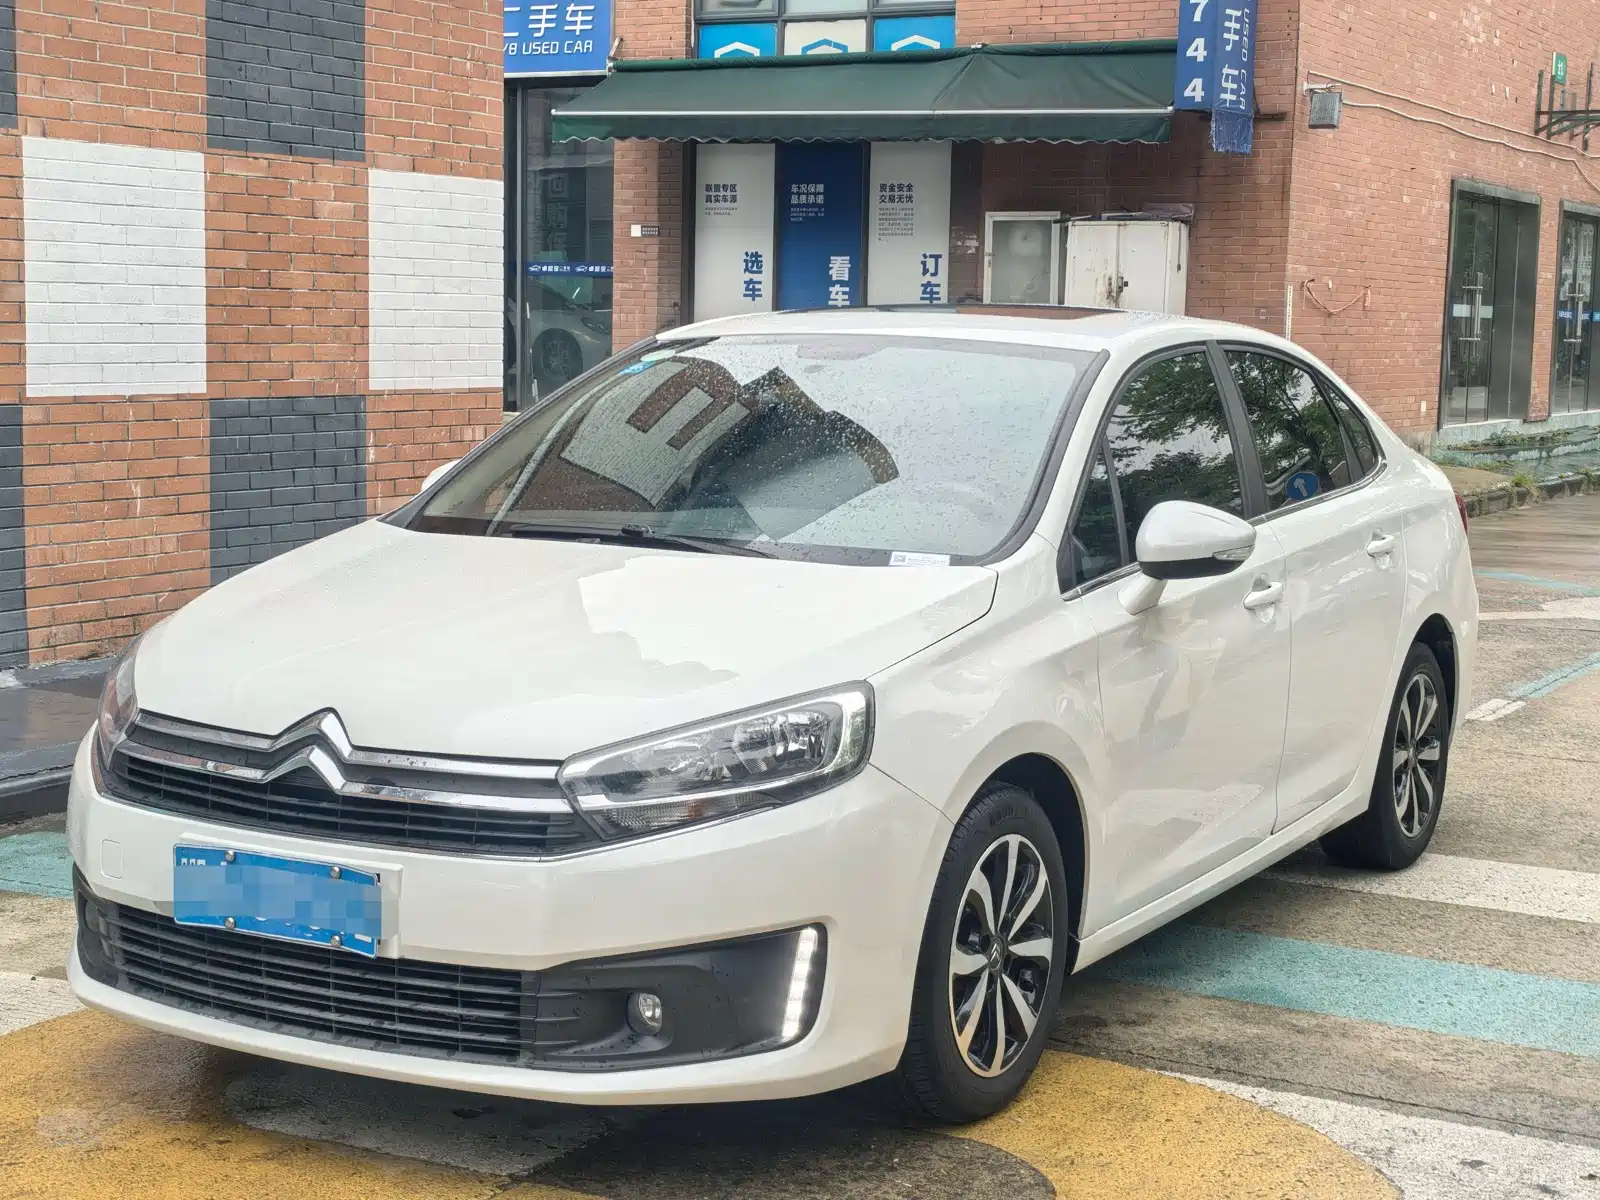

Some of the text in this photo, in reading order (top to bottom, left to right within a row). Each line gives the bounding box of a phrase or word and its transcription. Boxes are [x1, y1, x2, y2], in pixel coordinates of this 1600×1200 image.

[503, 3, 595, 37] 二手车
[522, 41, 559, 54] USED
[564, 40, 593, 53] CAR
[1220, 8, 1242, 107] 手车
[1239, 8, 1250, 109] USED CAR
[704, 183, 738, 193] 联盟专区
[791, 183, 825, 193] 车况保障
[879, 182, 914, 192] 资金安全
[704, 194, 738, 204] 真实车源
[790, 194, 825, 204] 品质承诺
[878, 194, 914, 204] 交易无忧
[743, 251, 763, 302] 选车
[828, 256, 851, 307] 看车
[920, 253, 942, 304] 订车
